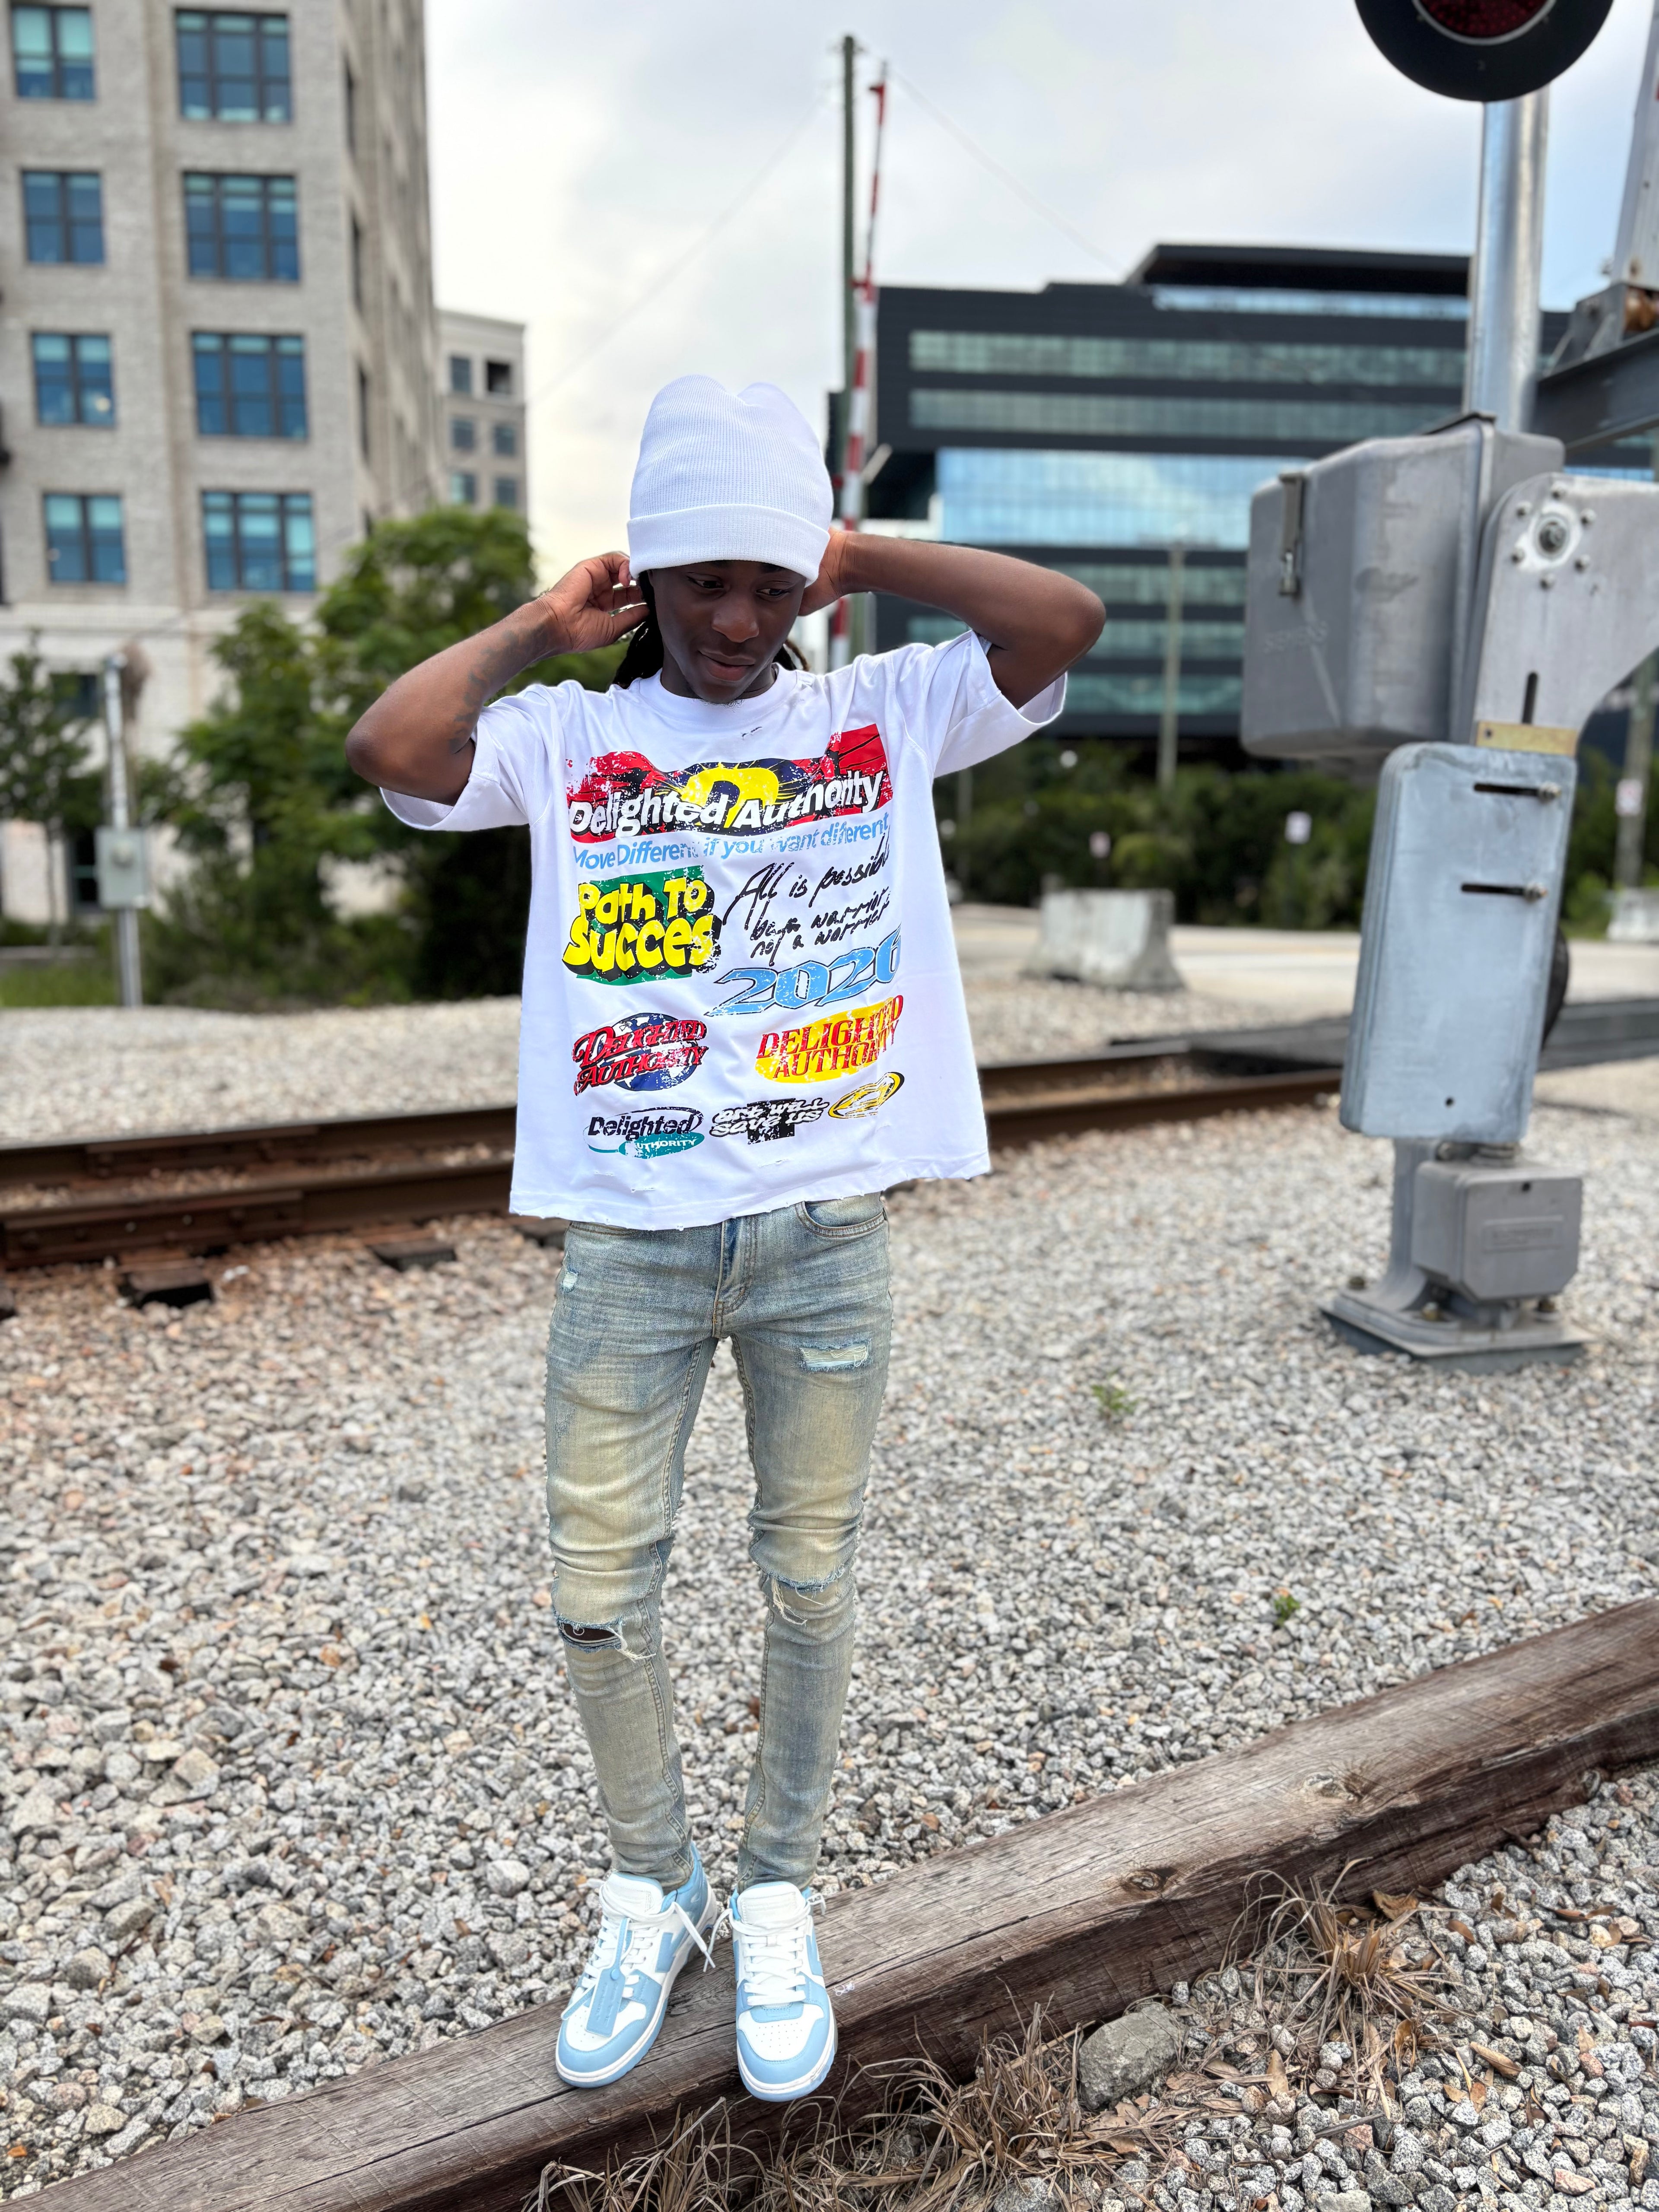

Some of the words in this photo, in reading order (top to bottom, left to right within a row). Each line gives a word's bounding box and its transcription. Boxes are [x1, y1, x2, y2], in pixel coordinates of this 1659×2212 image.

[570, 788, 729, 837] Delighted
[732, 769, 884, 829] Authority
[573, 845, 615, 870] Move
[617, 840, 699, 866] Different
[703, 837, 721, 856] if
[721, 839, 764, 860] you
[770, 829, 820, 853] want
[722, 862, 795, 930] All
[789, 874, 808, 898] is
[808, 827, 890, 908] possibl
[578, 882, 660, 925] Path
[810, 886, 889, 928] warrior
[750, 927, 786, 967] not
[792, 934, 804, 950] a
[756, 995, 904, 1059] DELIGHTED
[588, 1114, 695, 1141] Delighted
[709, 1115, 782, 1137] save
[785, 1109, 824, 1125] us
[635, 1138, 697, 1152] UTHORITY
